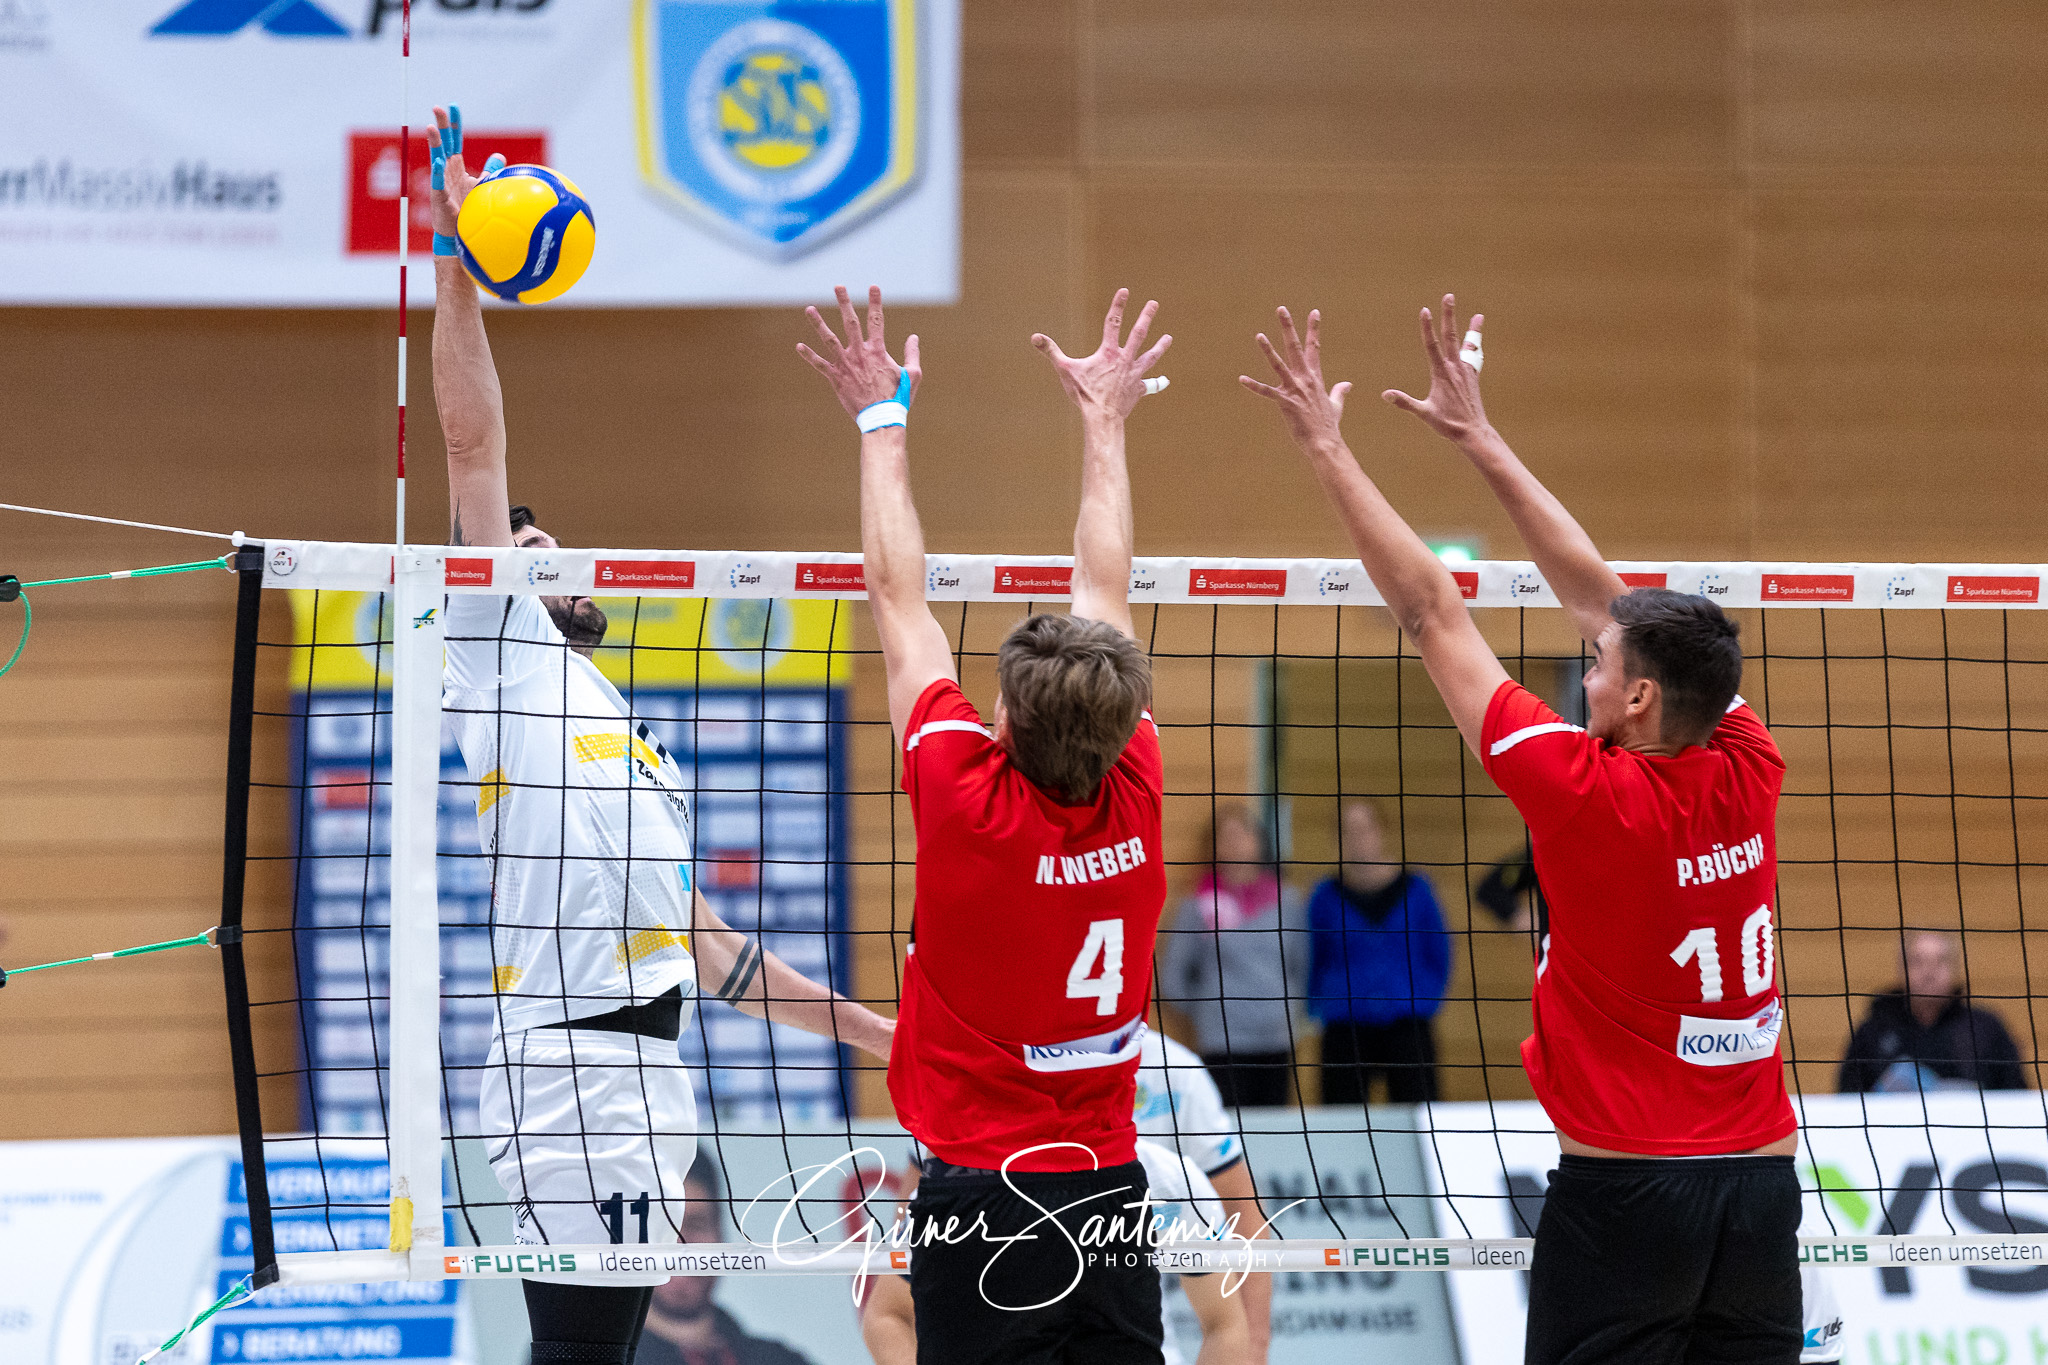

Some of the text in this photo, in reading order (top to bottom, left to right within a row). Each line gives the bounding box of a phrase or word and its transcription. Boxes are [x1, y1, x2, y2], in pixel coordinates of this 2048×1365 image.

[450, 571, 486, 580] Nürnberg
[537, 572, 560, 582] Zapf
[615, 572, 688, 583] Sparkasse Nürnberg
[739, 574, 761, 584] Zapf
[816, 575, 852, 585] Sparkasse
[938, 577, 960, 588] Zapf
[1014, 578, 1051, 588] Sparkasse
[1134, 580, 1156, 590] Zapf
[1209, 581, 1280, 592] Sparkasse Nürnberg
[1327, 582, 1349, 593] Zapf
[1519, 584, 1540, 594] Zapf
[1707, 585, 1729, 595] Zapf
[1780, 586, 1848, 597] Sparkasse Nürnberg
[1894, 587, 1915, 597] Zapf
[1966, 587, 2033, 598] Sparkasse Nürnberg
[1035, 836, 1147, 885] N.WEBER
[1669, 903, 1774, 1003] 10
[1066, 918, 1125, 1016] 4
[600, 1192, 649, 1244] 11
[1353, 1246, 1525, 1266] FUCHS Ideen
[1890, 1242, 1942, 1262] Ideen
[1949, 1242, 2043, 1262] umsetzen
[475, 1252, 767, 1273] FUCHS Ideen umsetzen
